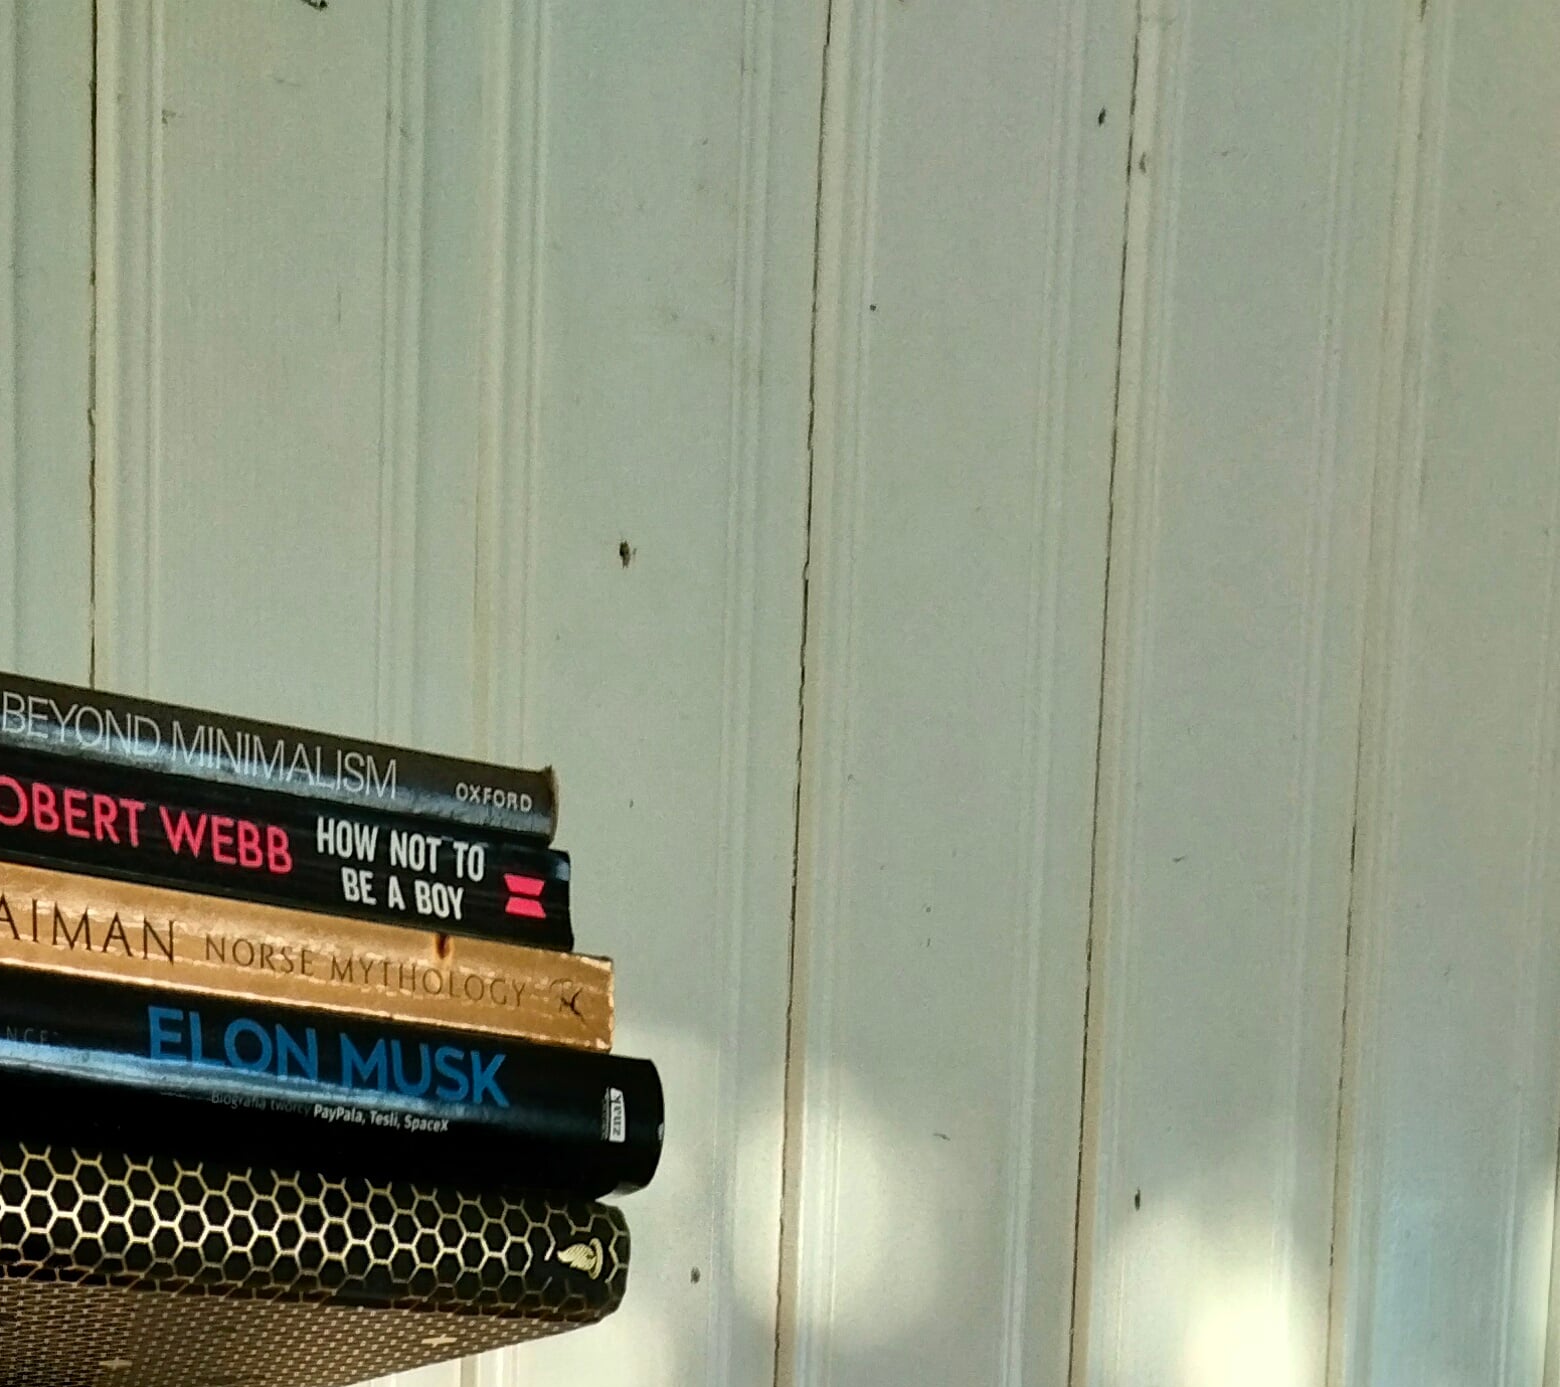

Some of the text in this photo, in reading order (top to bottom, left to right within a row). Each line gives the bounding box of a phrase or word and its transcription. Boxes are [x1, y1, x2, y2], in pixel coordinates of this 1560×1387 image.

[1, 690, 398, 801] BEYOND MINIMALISM
[455, 781, 533, 812] OXFORD
[159, 804, 293, 875] WEBB
[316, 815, 485, 882] HOW NOT TO
[341, 866, 465, 921] BE A BOY
[205, 934, 527, 1009] NORSE MYTHOLOGY
[148, 1004, 510, 1108] ELON MUSK
[313, 1102, 366, 1126] PayPala,
[370, 1110, 402, 1130] Tesli,
[404, 1114, 449, 1133] SpaceX
